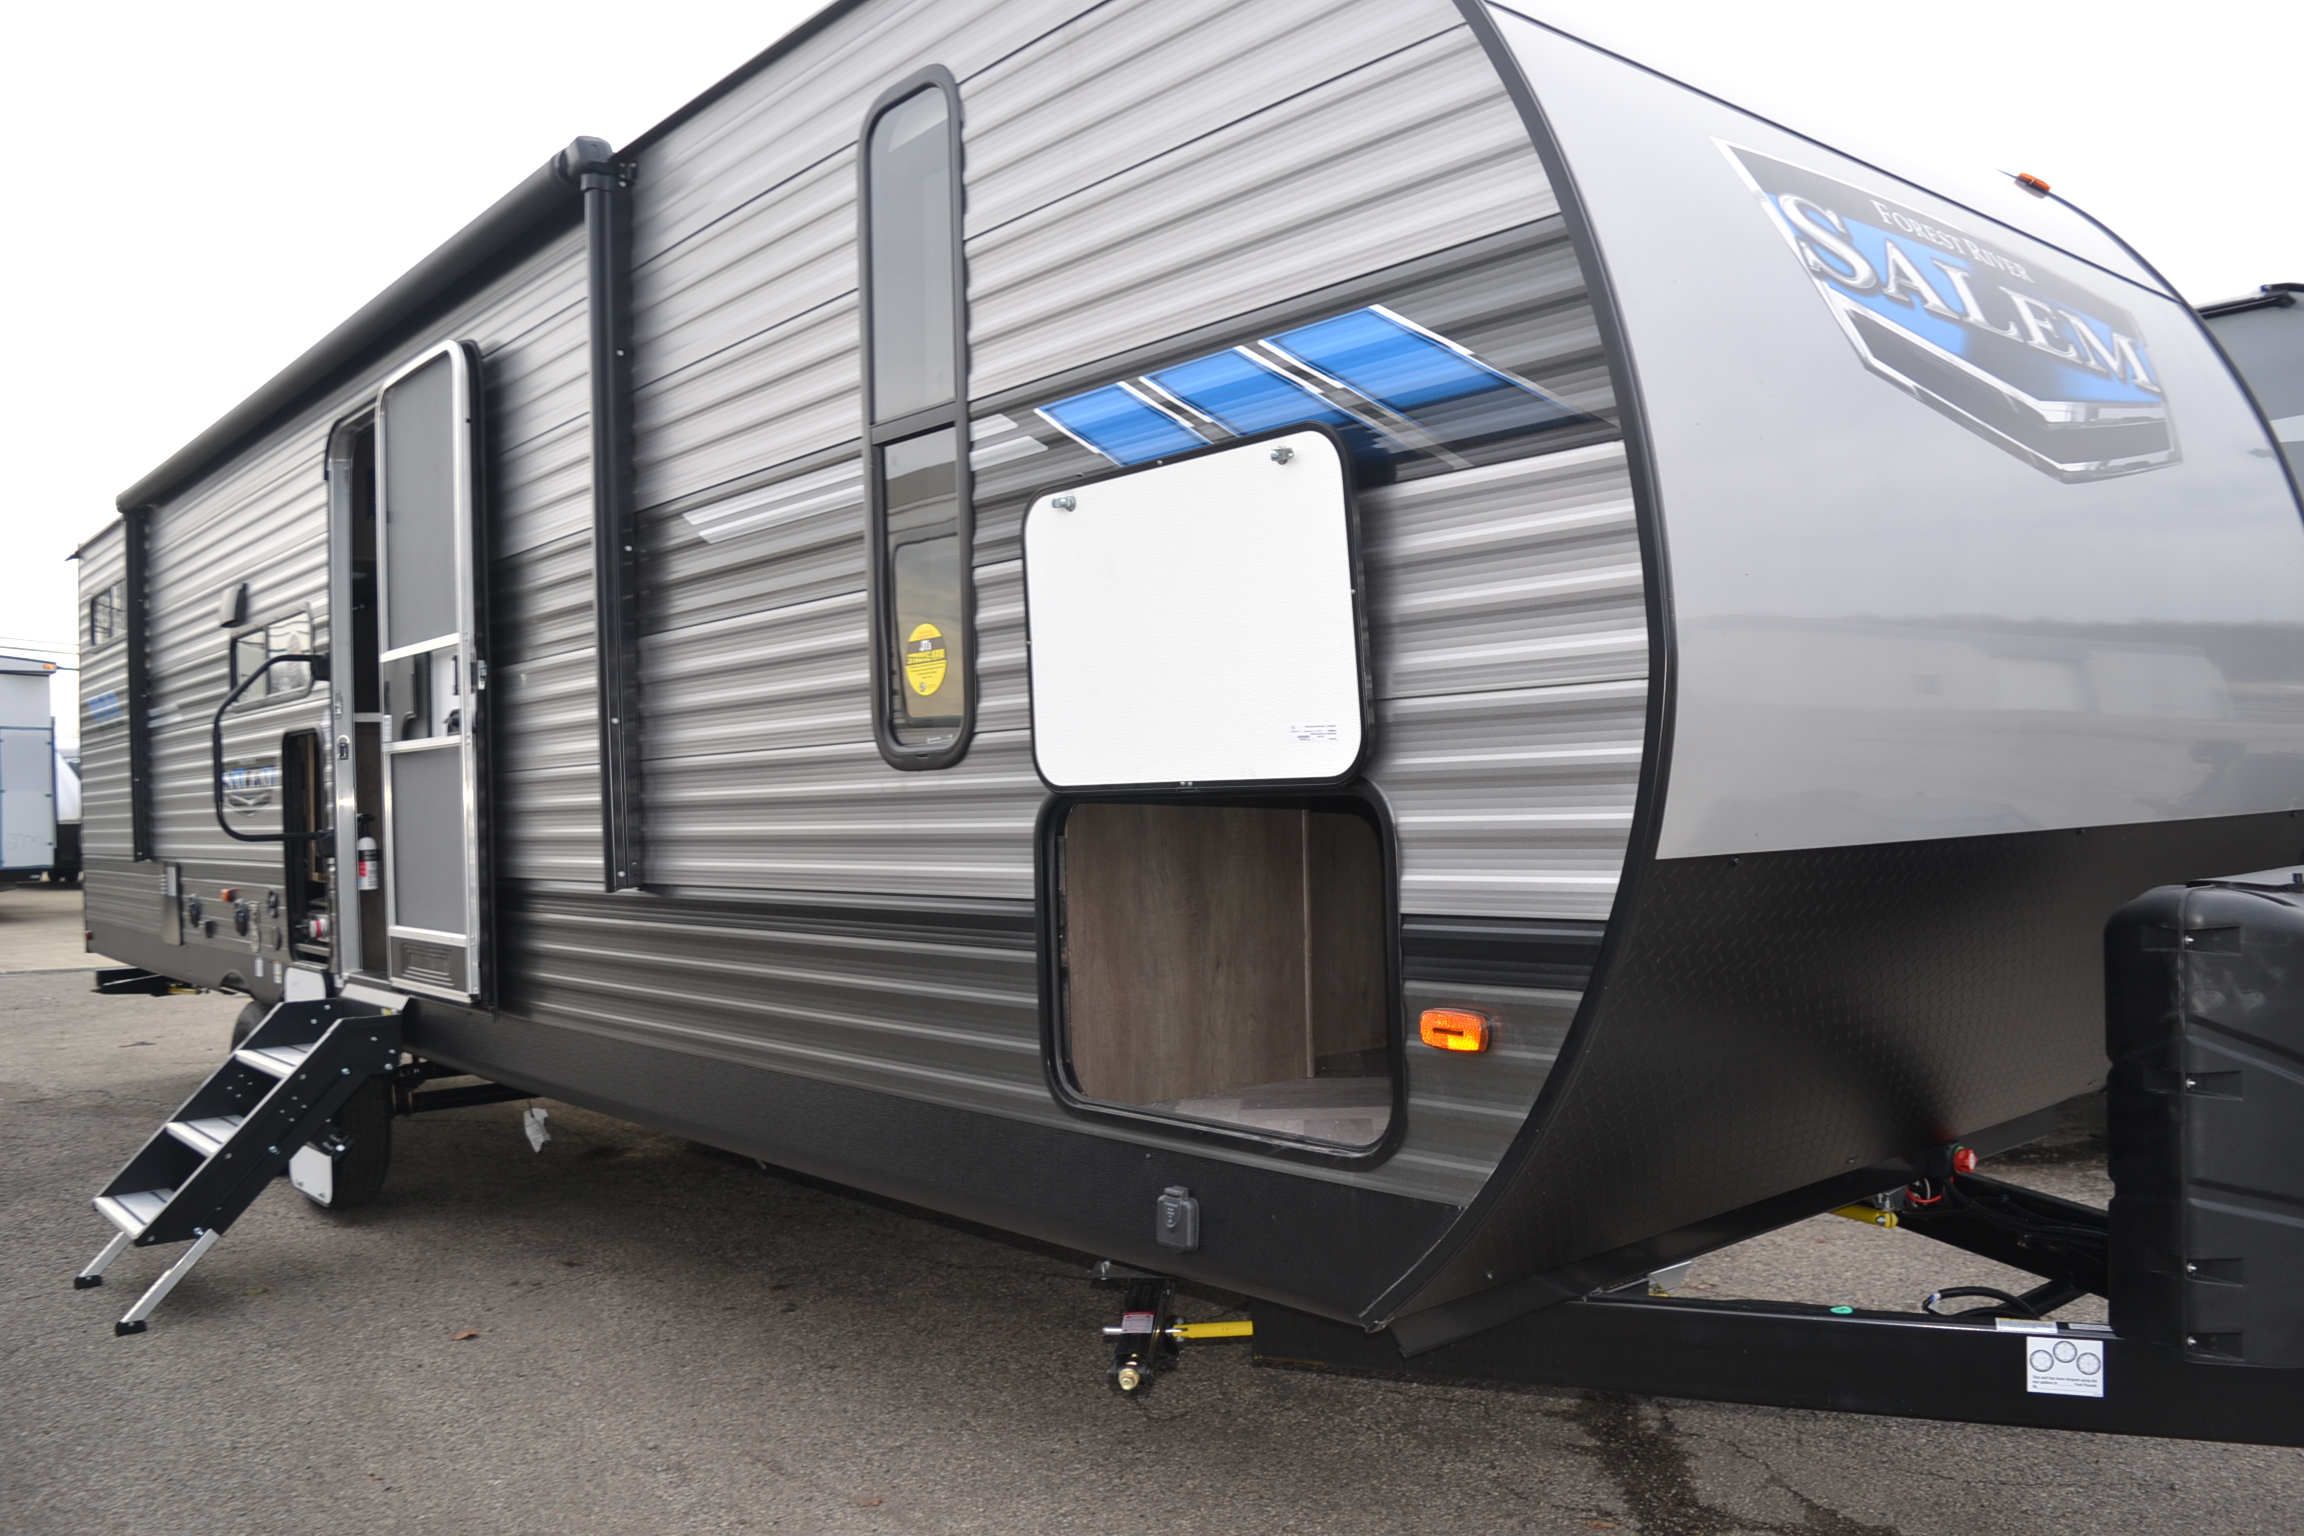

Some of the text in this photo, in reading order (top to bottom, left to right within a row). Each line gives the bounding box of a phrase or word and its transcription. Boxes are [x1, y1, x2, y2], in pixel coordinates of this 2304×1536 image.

[1777, 191, 2162, 394] SALEM
[1869, 198, 2035, 284] FOREST RIVER
